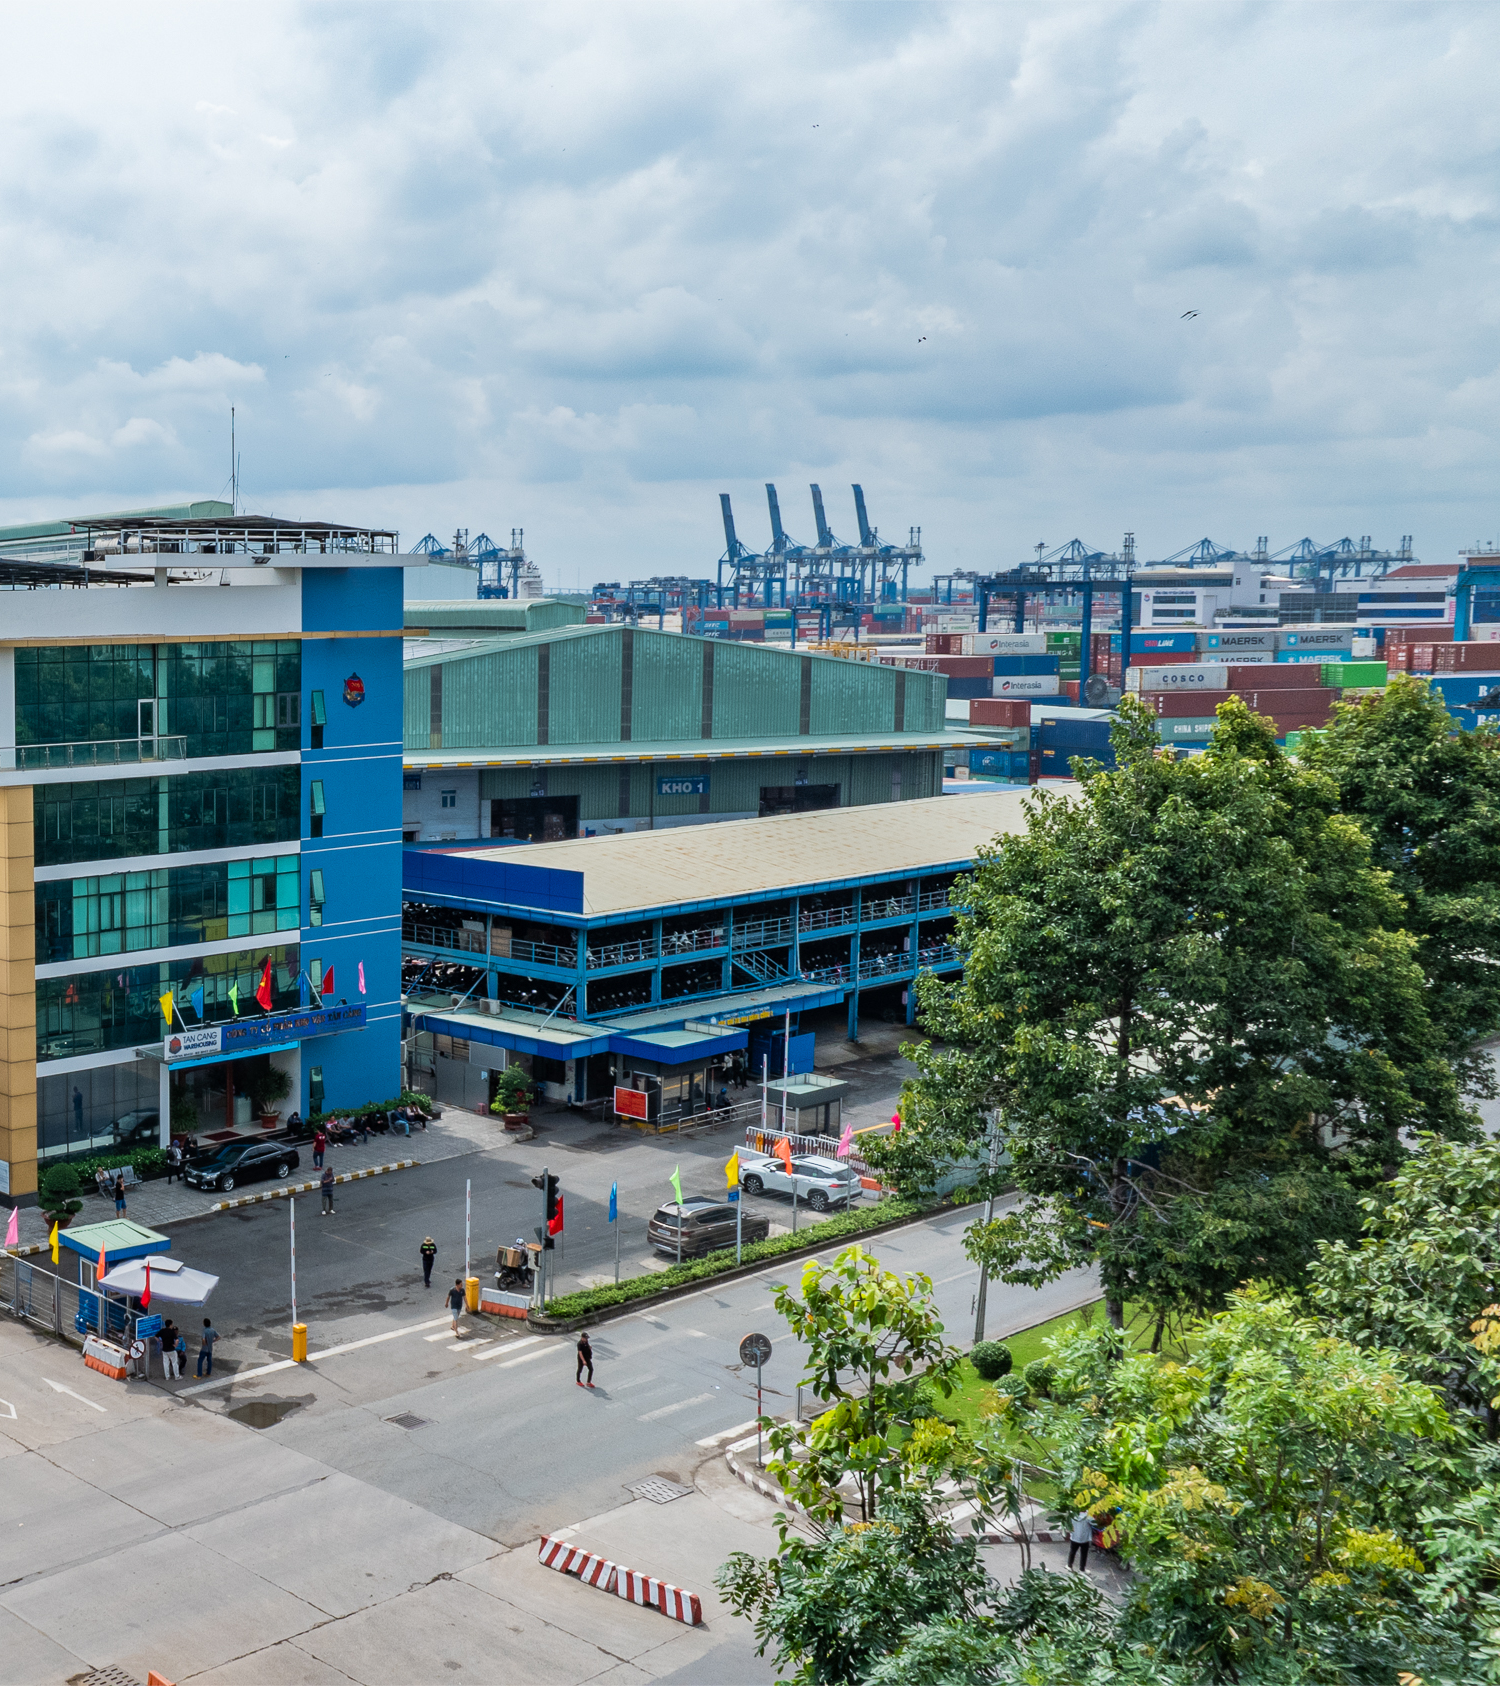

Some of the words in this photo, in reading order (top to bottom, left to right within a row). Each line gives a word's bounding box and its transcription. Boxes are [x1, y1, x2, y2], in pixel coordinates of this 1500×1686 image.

[1221, 637, 1265, 645] MAERSK
[1300, 635, 1343, 644] MAERSK
[998, 640, 1030, 649] Interasia
[1299, 655, 1342, 663] MAERSK
[1162, 675, 1205, 683] COSCO
[1010, 681, 1042, 690] Interasia
[1174, 724, 1192, 734] CHINA
[1195, 723, 1213, 733] SHIPP
[662, 783, 692, 794] KHO
[697, 782, 703, 793] 1
[183, 1034, 196, 1044] TAN
[197, 1032, 218, 1042] CANG
[184, 1040, 218, 1050] WAREHOUSING
